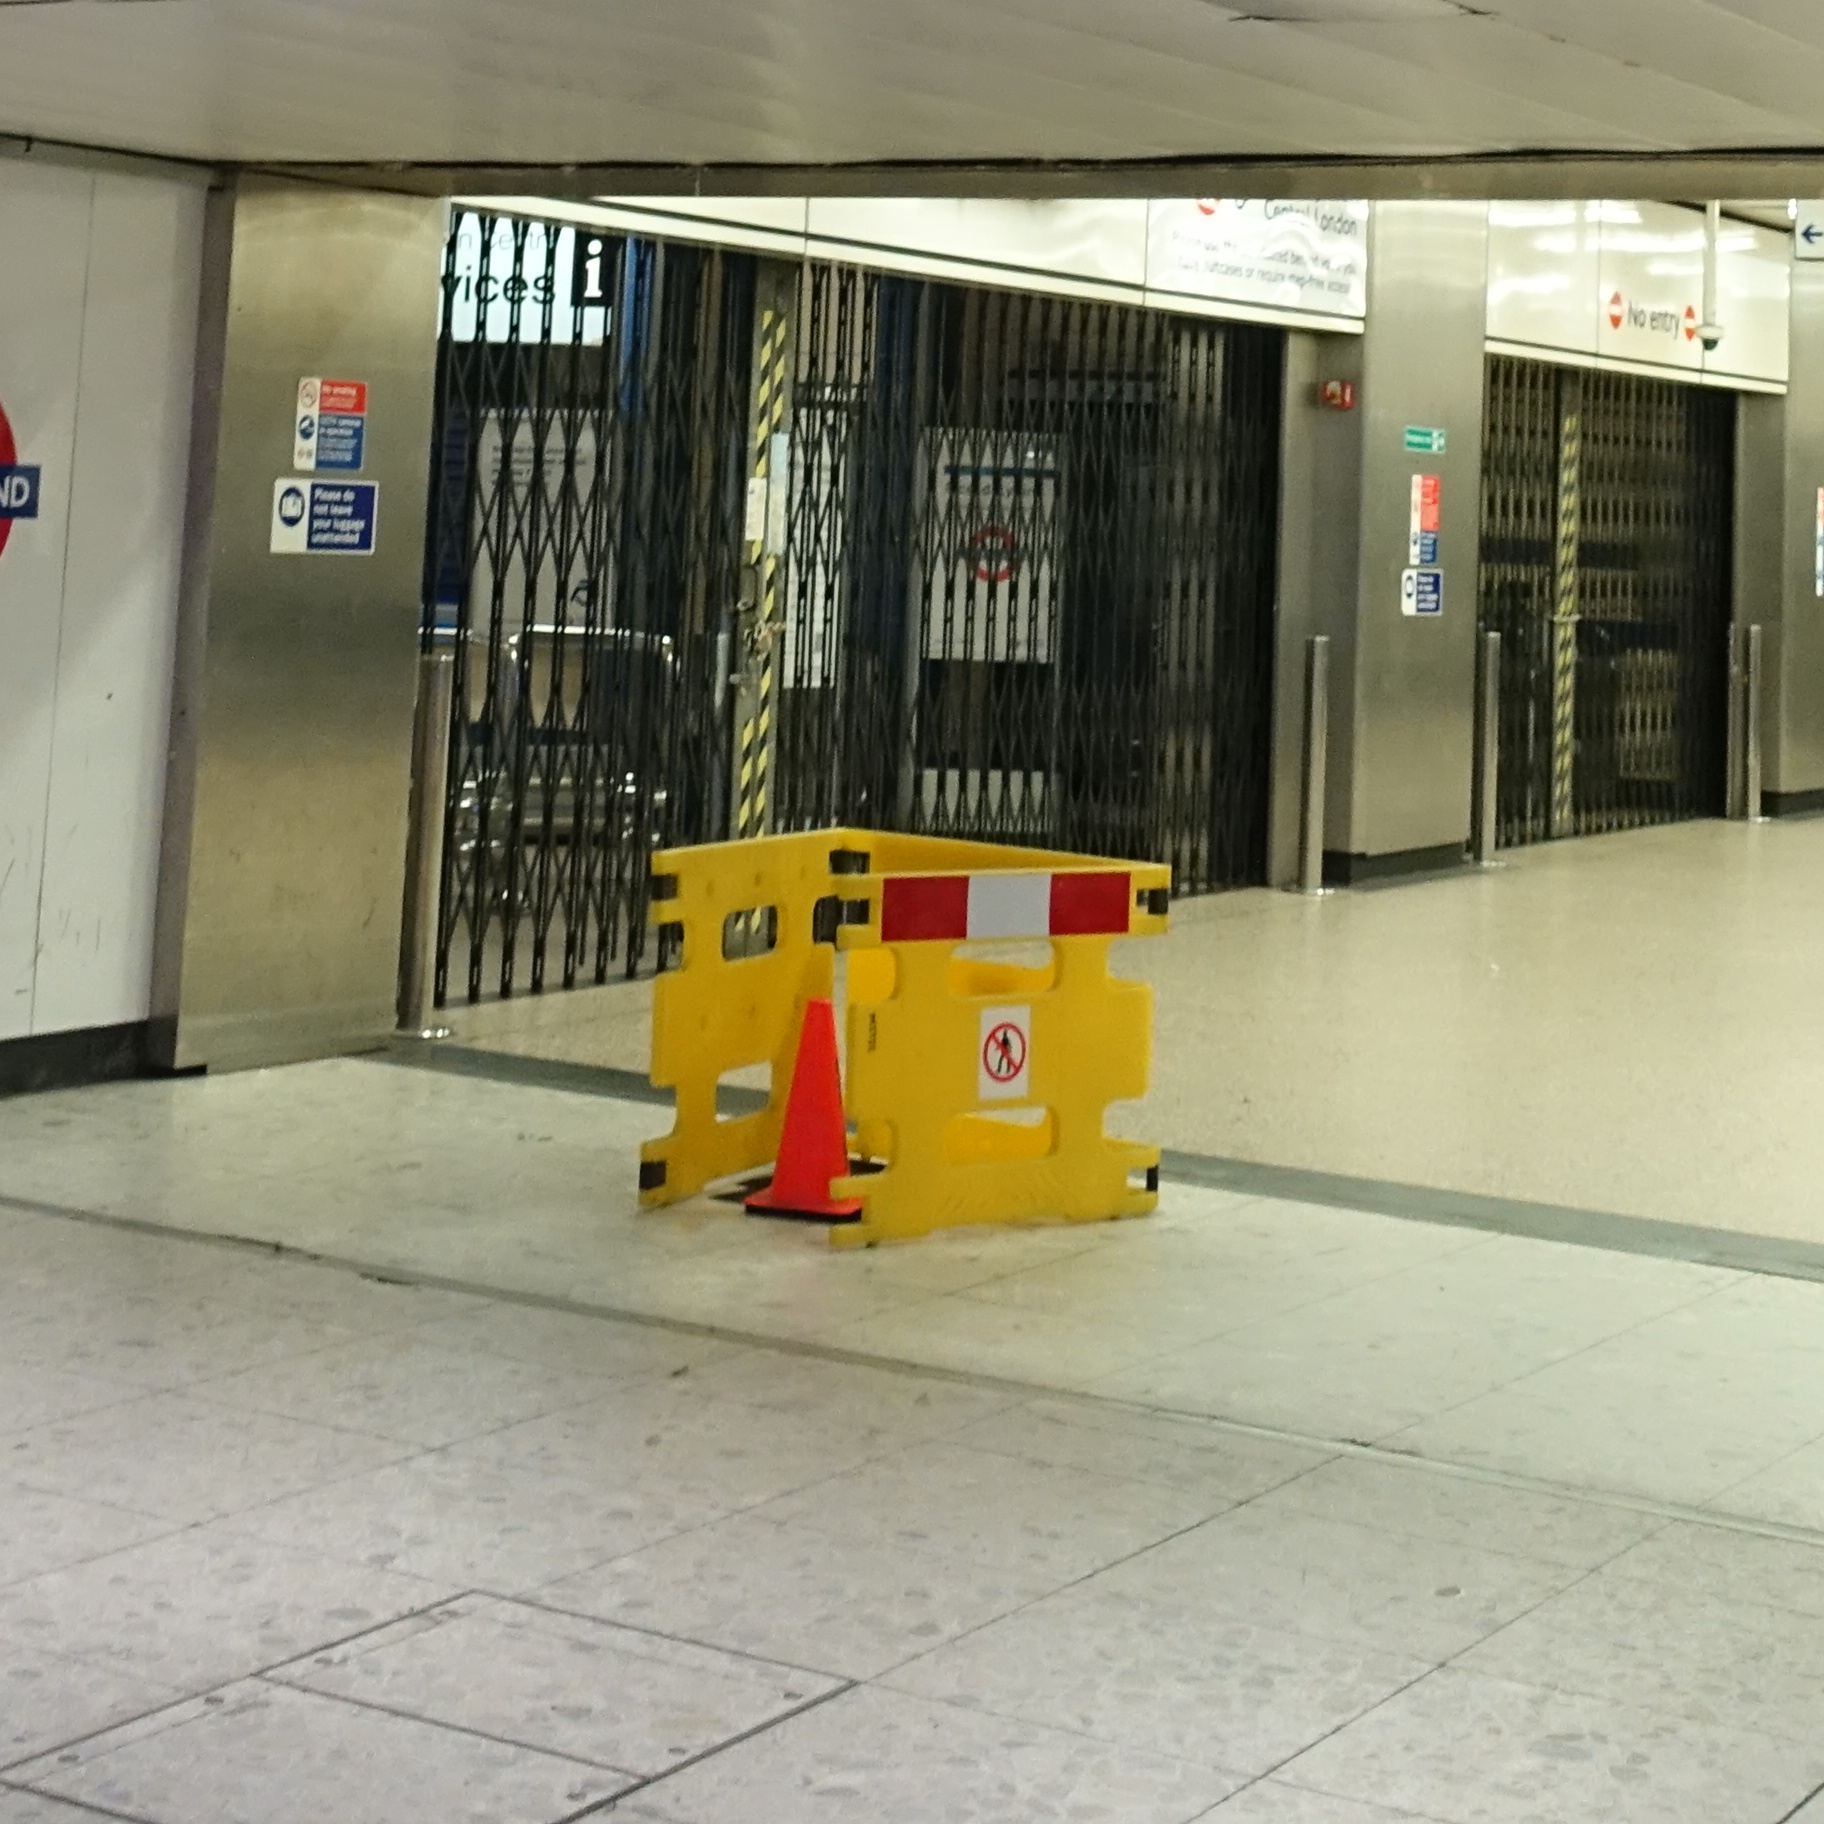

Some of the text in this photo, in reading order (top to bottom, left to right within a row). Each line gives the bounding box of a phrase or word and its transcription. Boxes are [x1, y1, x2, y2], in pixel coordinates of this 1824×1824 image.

[1627, 300, 1680, 341] No entry
[313, 487, 356, 502] Please do
[312, 503, 354, 517] not leave
[312, 518, 332, 532] your
